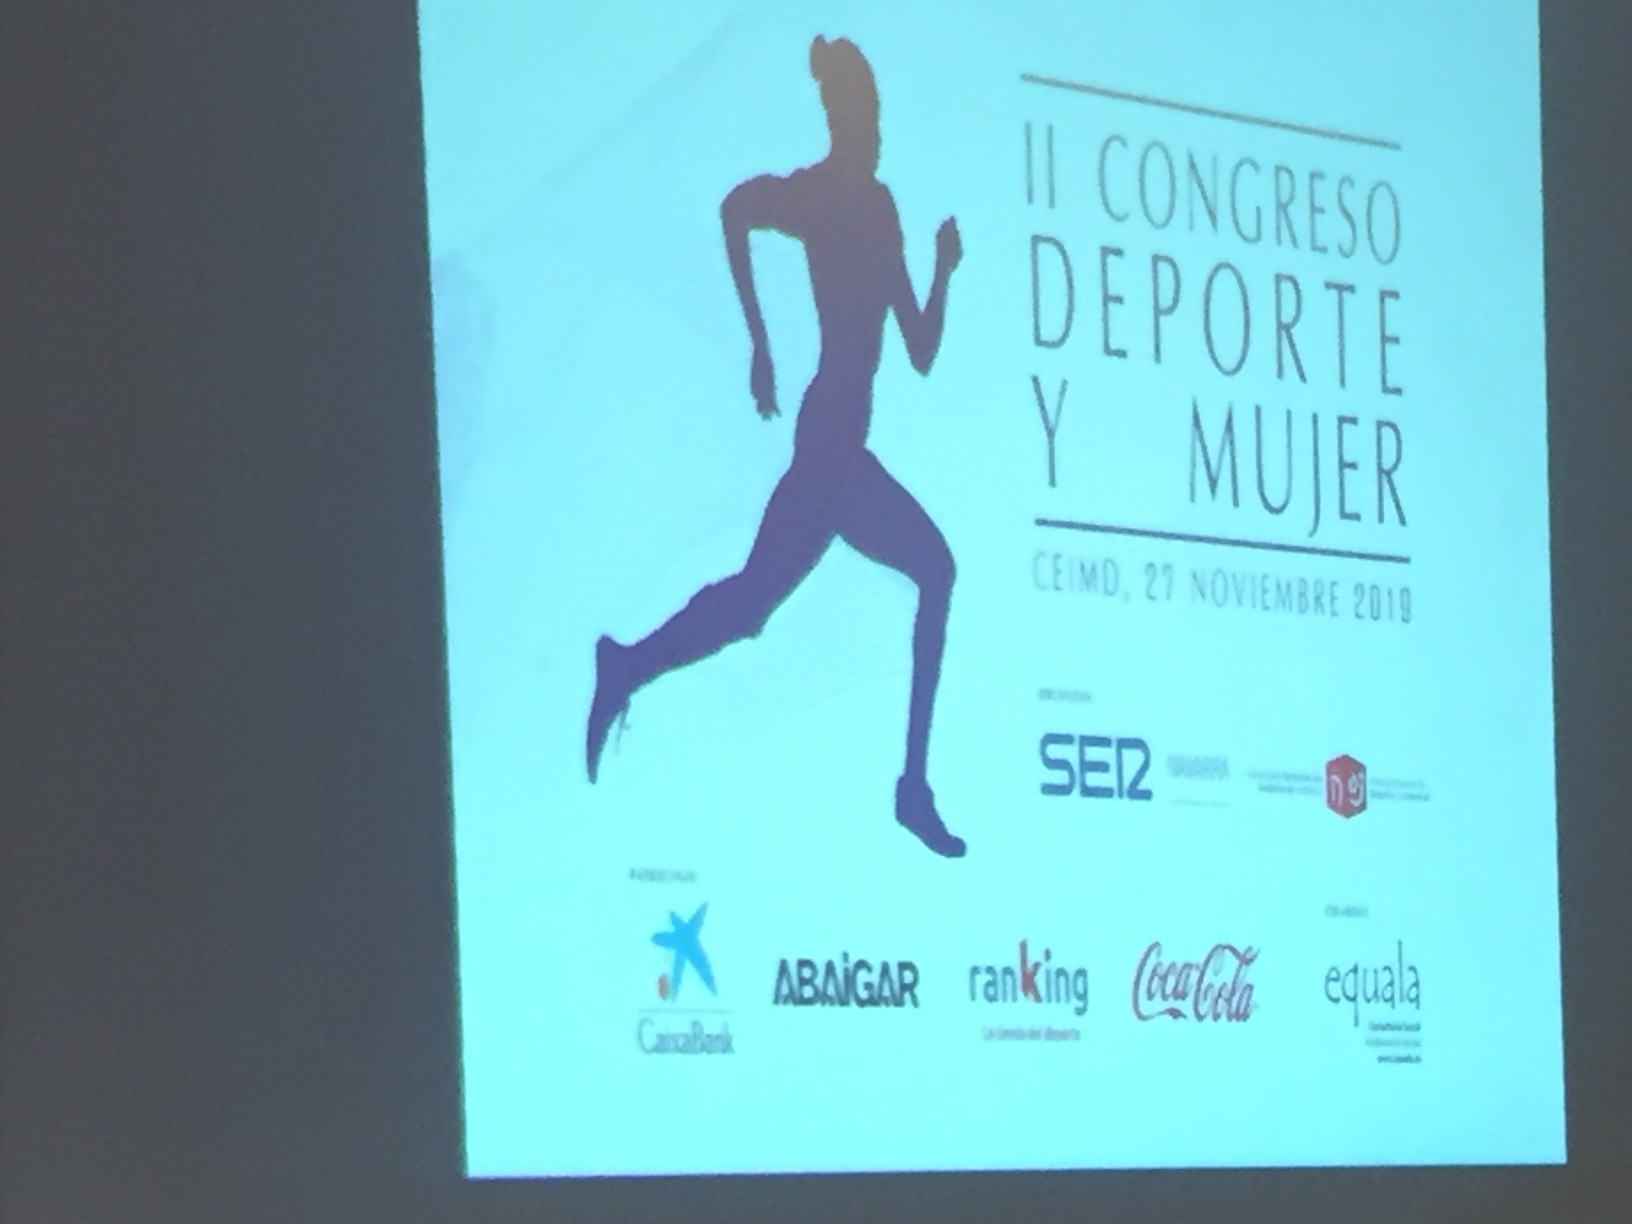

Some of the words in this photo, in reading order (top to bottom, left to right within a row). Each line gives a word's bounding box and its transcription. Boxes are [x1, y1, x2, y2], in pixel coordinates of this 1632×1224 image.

[1023, 120, 1055, 210] II
[1099, 134, 1400, 265] CONGRESO
[1031, 234, 1403, 396] DEPORTE
[1031, 374, 1068, 488] Y
[1189, 399, 1407, 537] MUJER
[1144, 562, 1172, 602] 27
[1190, 568, 1340, 618] NOVIEMBRE
[1353, 582, 1413, 625] 2019
[1039, 732, 1154, 802] SER
[968, 938, 1089, 1016] ranking
[1324, 939, 1420, 1027] equala
[637, 1018, 736, 1055] CaixaBank
